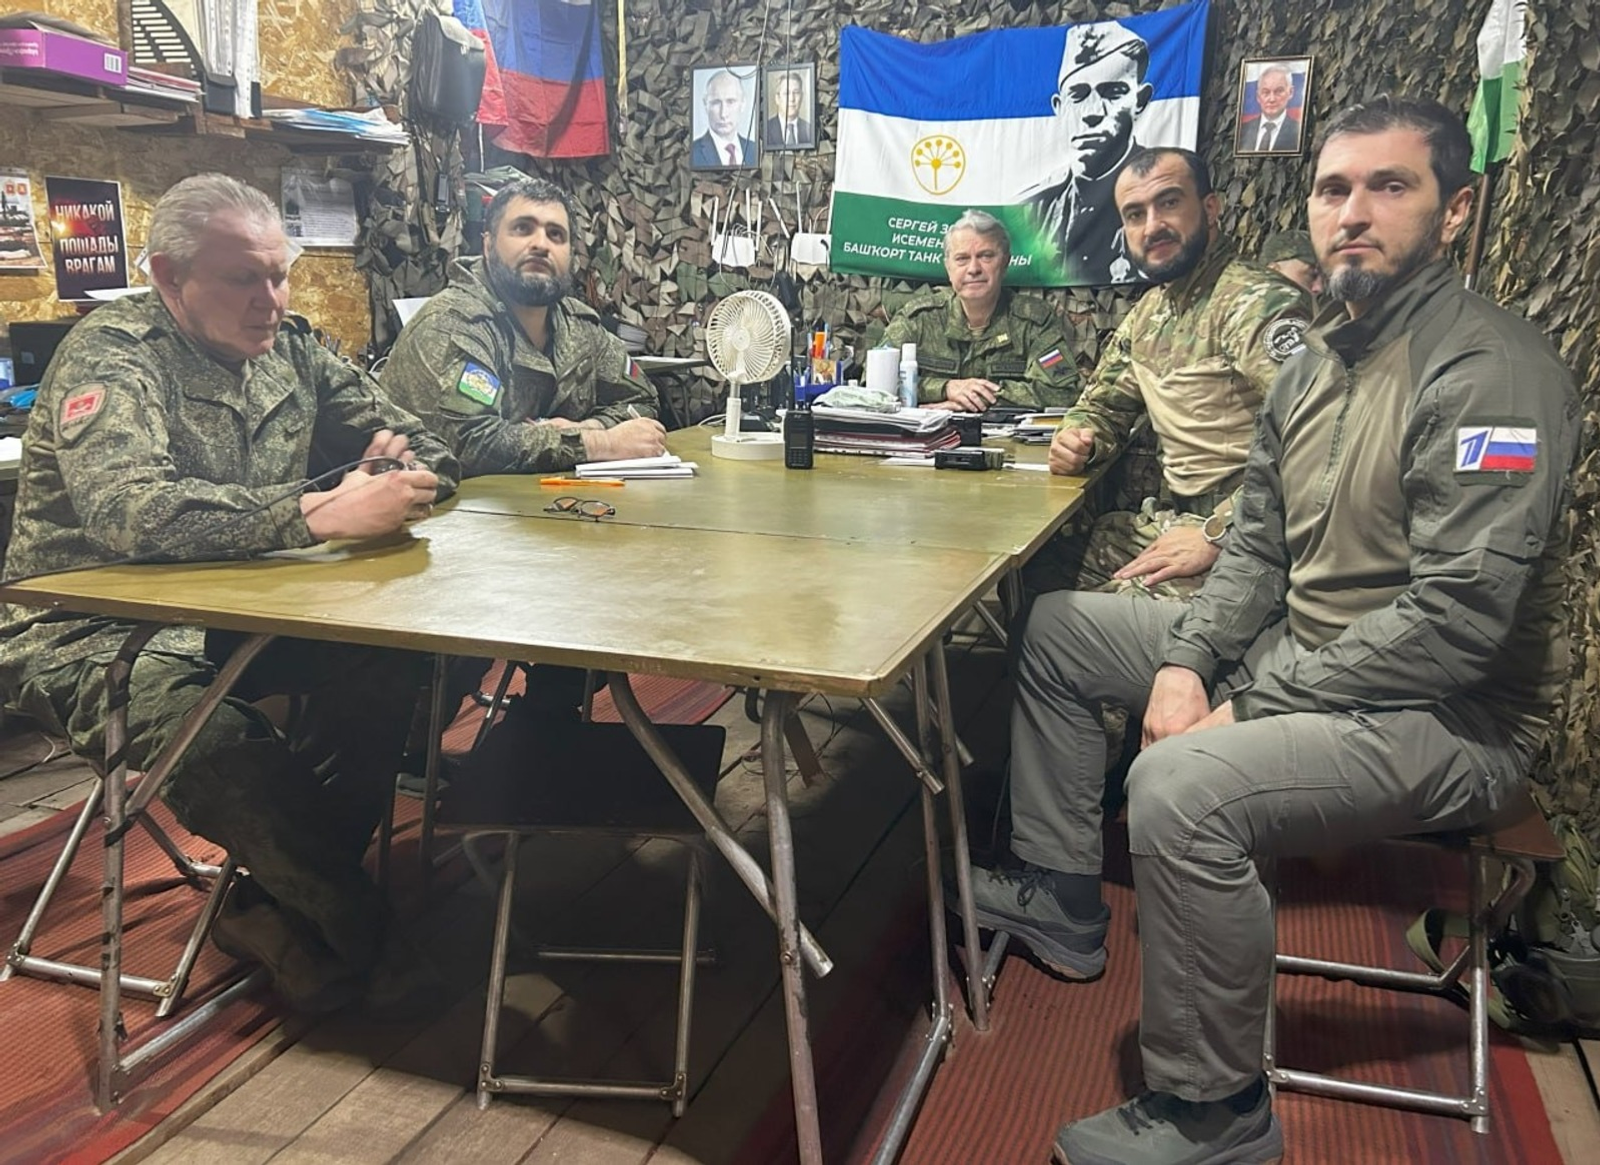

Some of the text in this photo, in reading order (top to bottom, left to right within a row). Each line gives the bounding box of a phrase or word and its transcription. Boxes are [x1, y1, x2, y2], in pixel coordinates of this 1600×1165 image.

[55, 200, 115, 221] НИКАКОЙ
[888, 217, 938, 234] СЕРГЕЙ
[843, 241, 907, 260] БАШҠОРТ
[909, 251, 942, 263] ТАНК
[65, 255, 116, 274] ВРАГАМ
